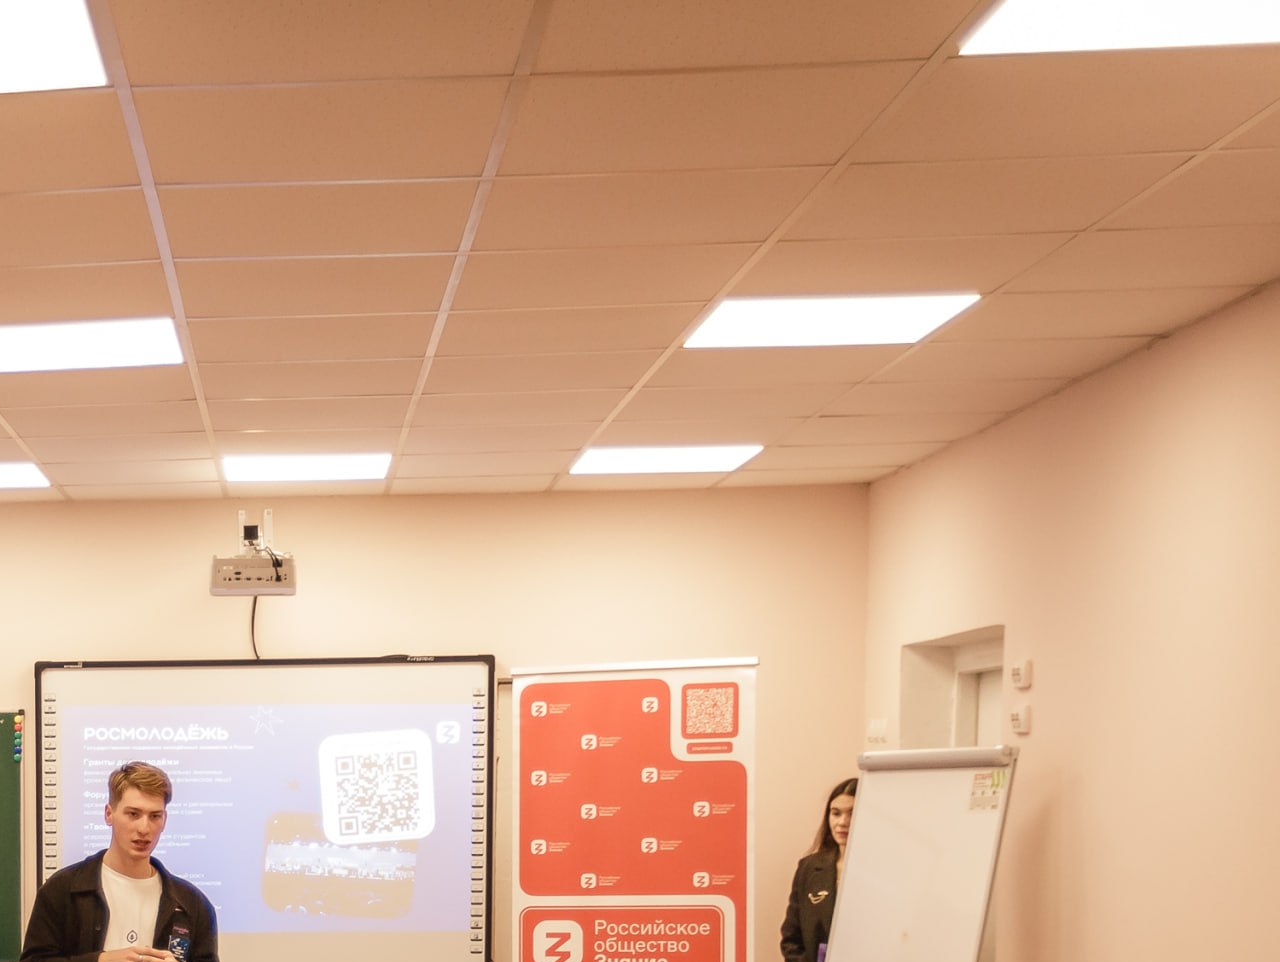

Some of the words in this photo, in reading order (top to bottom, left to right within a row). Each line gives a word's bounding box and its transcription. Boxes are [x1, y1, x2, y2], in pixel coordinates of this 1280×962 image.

[83, 724, 229, 741] РОСМОЛОДЁЖЬ
[594, 919, 711, 935] Российское
[594, 937, 690, 955] общество
